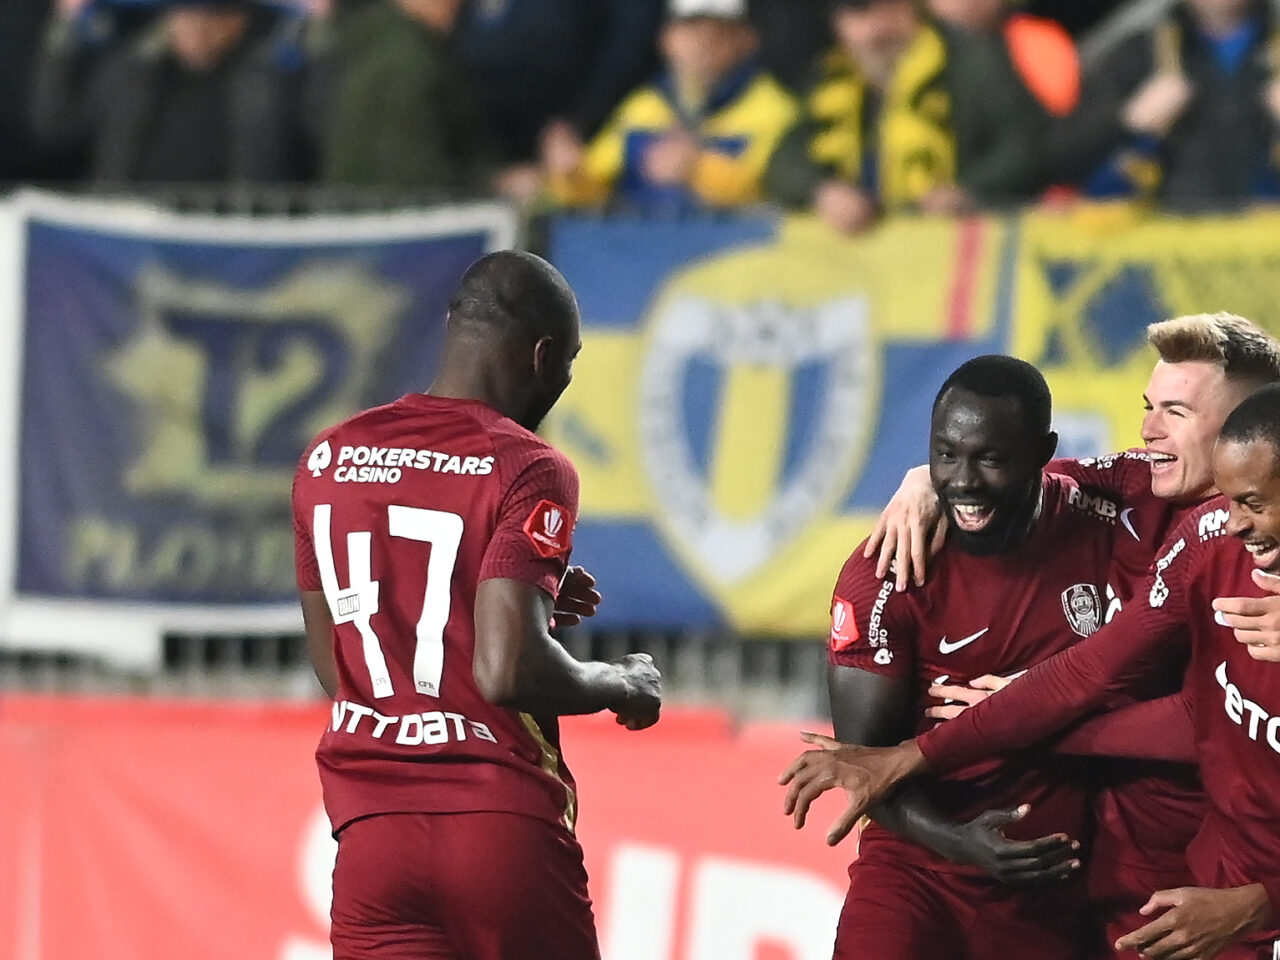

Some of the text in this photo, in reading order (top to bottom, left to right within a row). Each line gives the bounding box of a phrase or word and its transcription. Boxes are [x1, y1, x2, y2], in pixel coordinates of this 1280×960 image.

[333, 466, 402, 484] CASINO
[337, 446, 495, 475] POKERSTARS
[1068, 486, 1117, 518] RMB
[313, 503, 465, 699] 47
[327, 700, 398, 735] NTT
